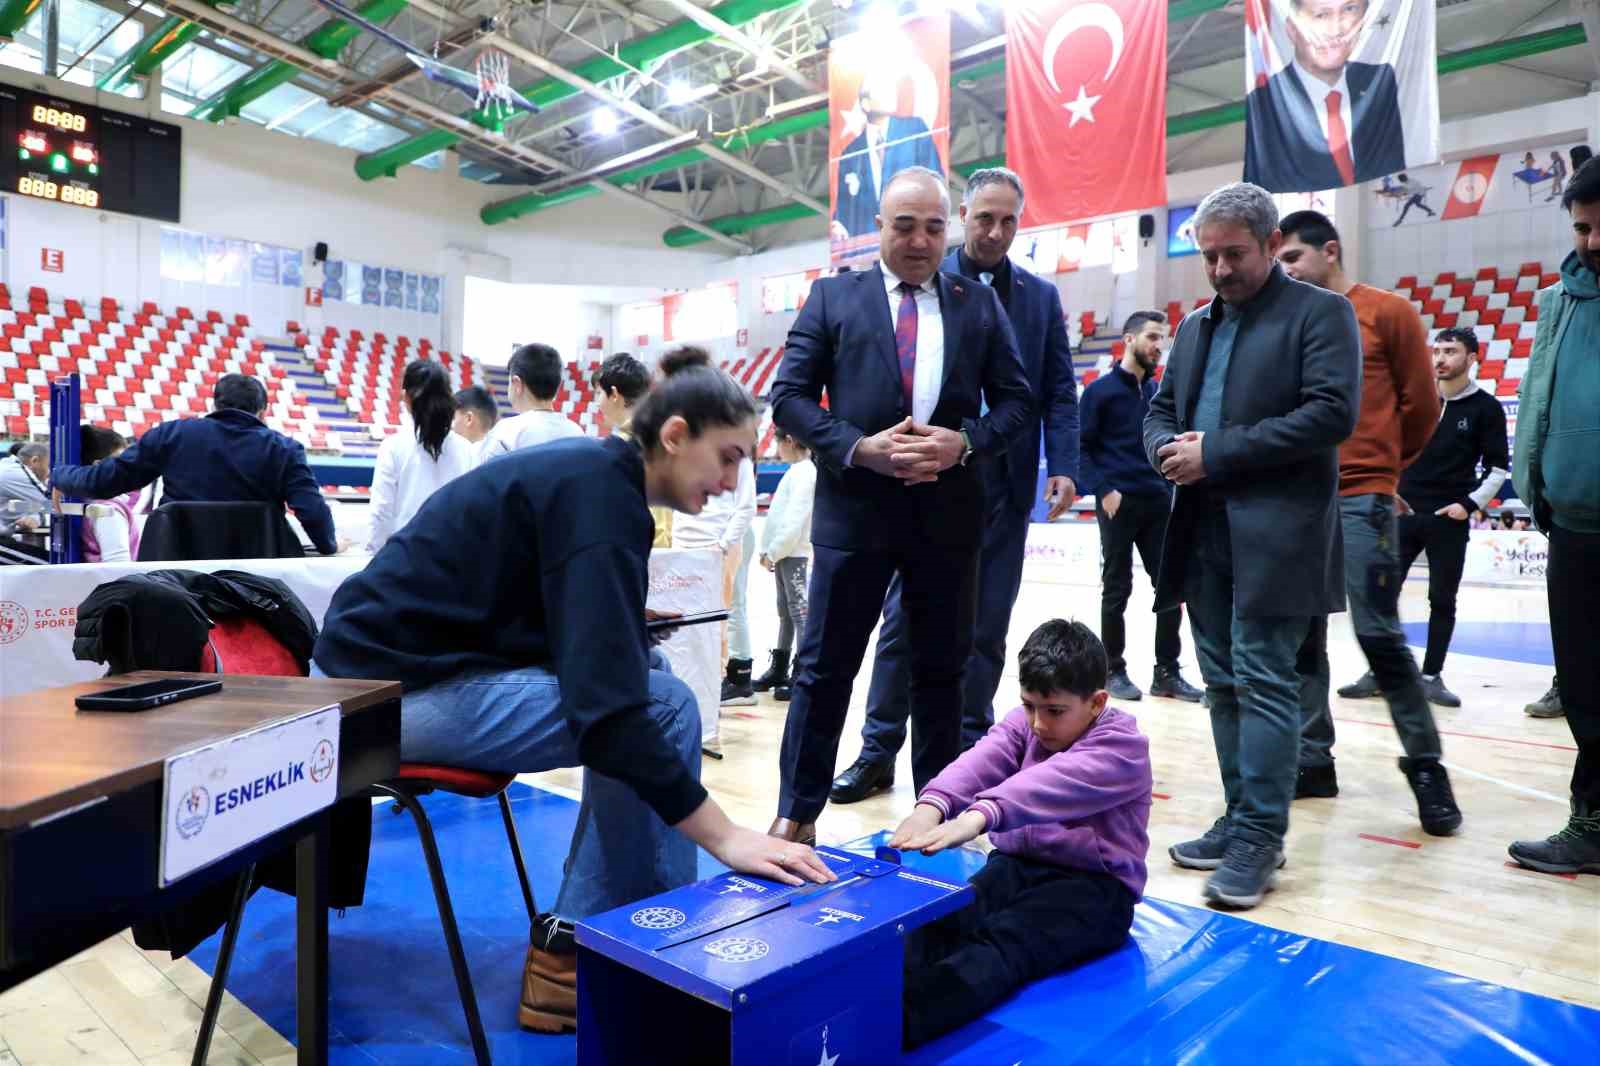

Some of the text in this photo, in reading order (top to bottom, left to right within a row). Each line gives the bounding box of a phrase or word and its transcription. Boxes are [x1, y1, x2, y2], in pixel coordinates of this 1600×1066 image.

[46, 250, 59, 267] E
[33, 607, 79, 618] T.C. GE
[34, 619, 65, 630] SPOR
[214, 761, 305, 816] ESNEKLİK
